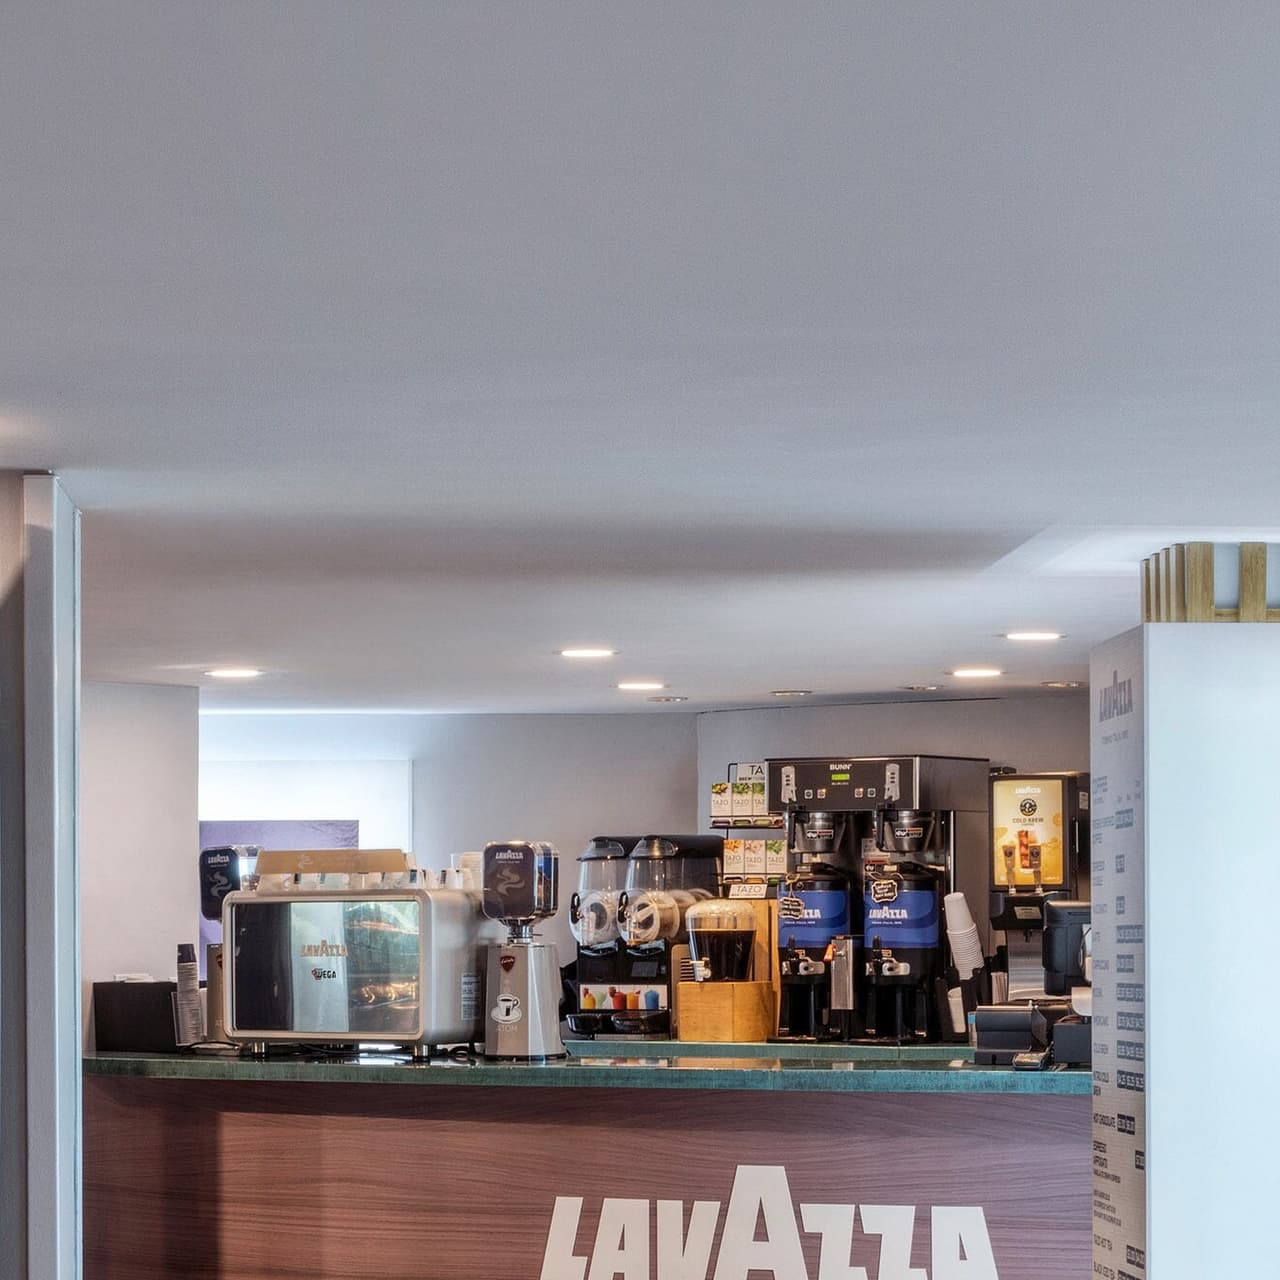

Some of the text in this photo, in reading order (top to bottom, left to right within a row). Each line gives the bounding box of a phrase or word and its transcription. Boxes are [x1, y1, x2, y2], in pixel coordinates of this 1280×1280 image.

[749, 765, 764, 775] TA
[829, 763, 852, 771] BUNN
[736, 885, 762, 893] TAZO
